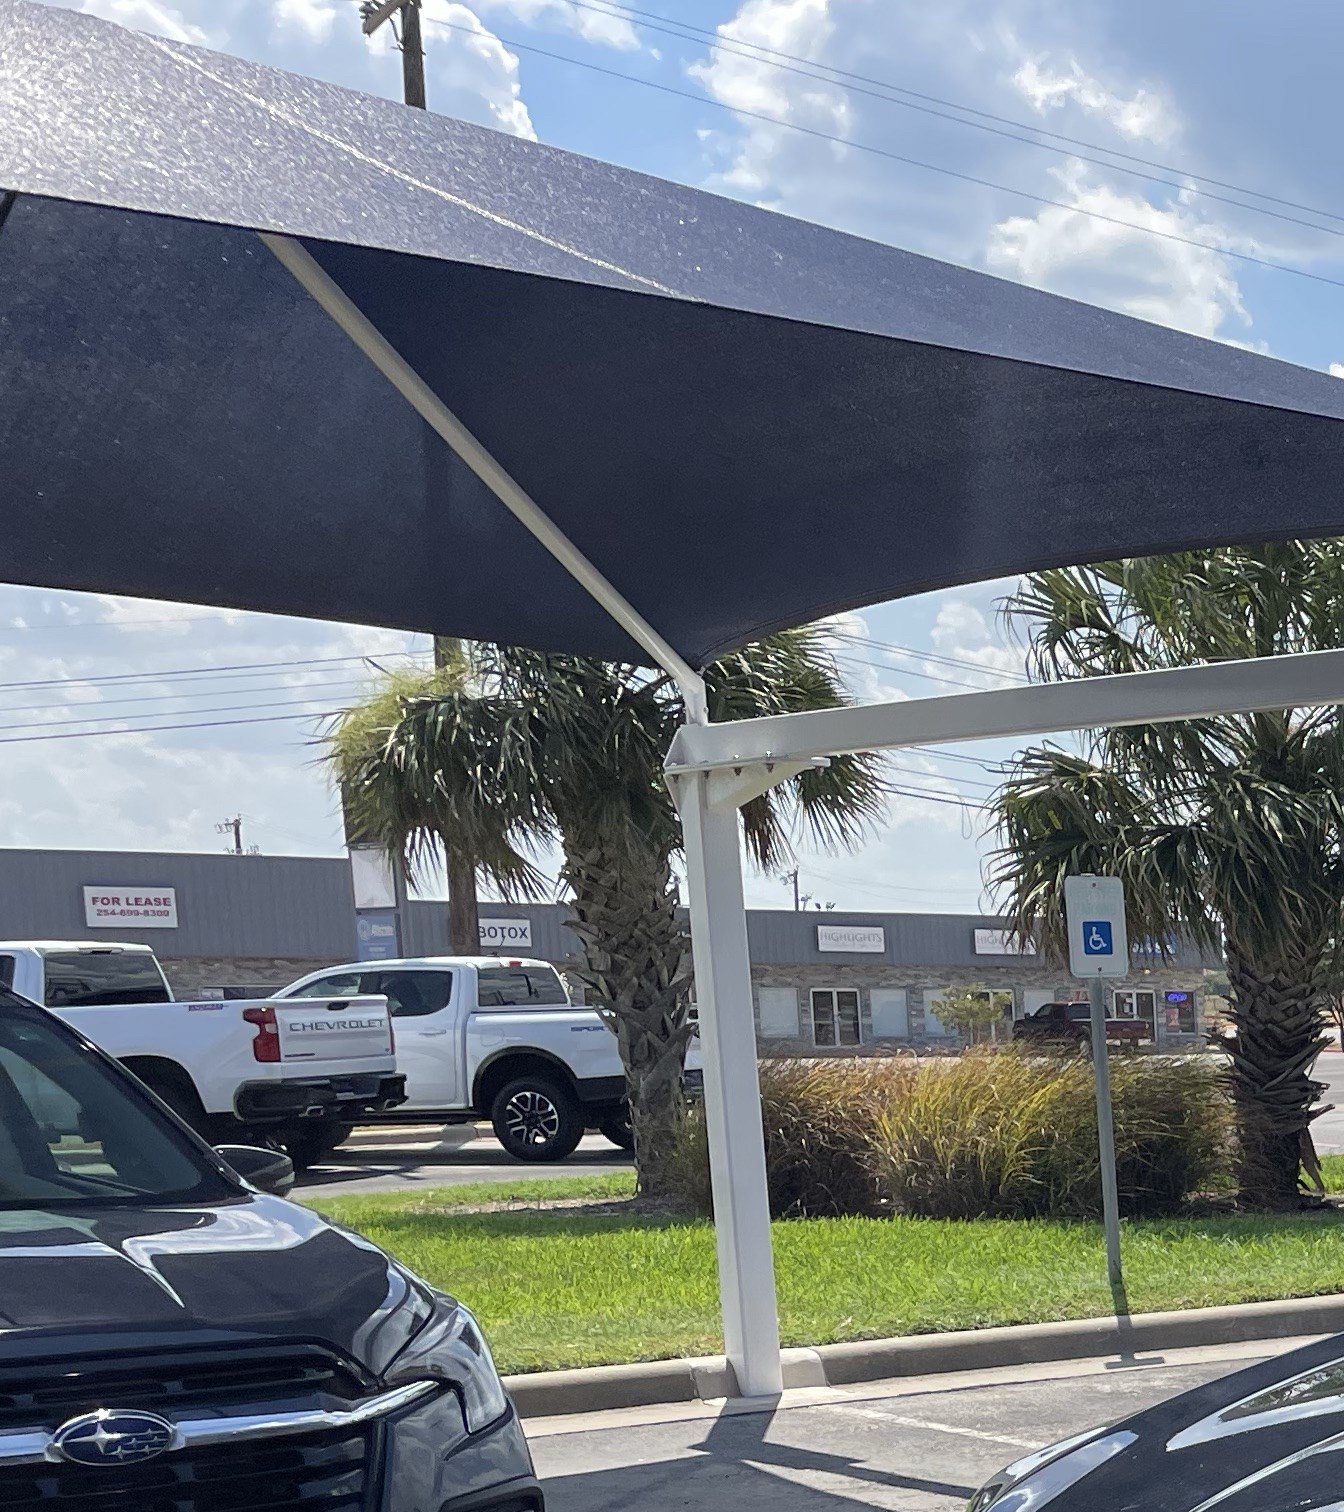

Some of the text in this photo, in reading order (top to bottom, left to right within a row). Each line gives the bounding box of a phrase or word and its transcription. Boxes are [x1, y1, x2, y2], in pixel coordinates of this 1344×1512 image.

[91, 896, 172, 907] FOR LEASE
[478, 926, 529, 940] BOTOX
[289, 1018, 385, 1032] CHEVROLET
[570, 1025, 605, 1033] SPOR
